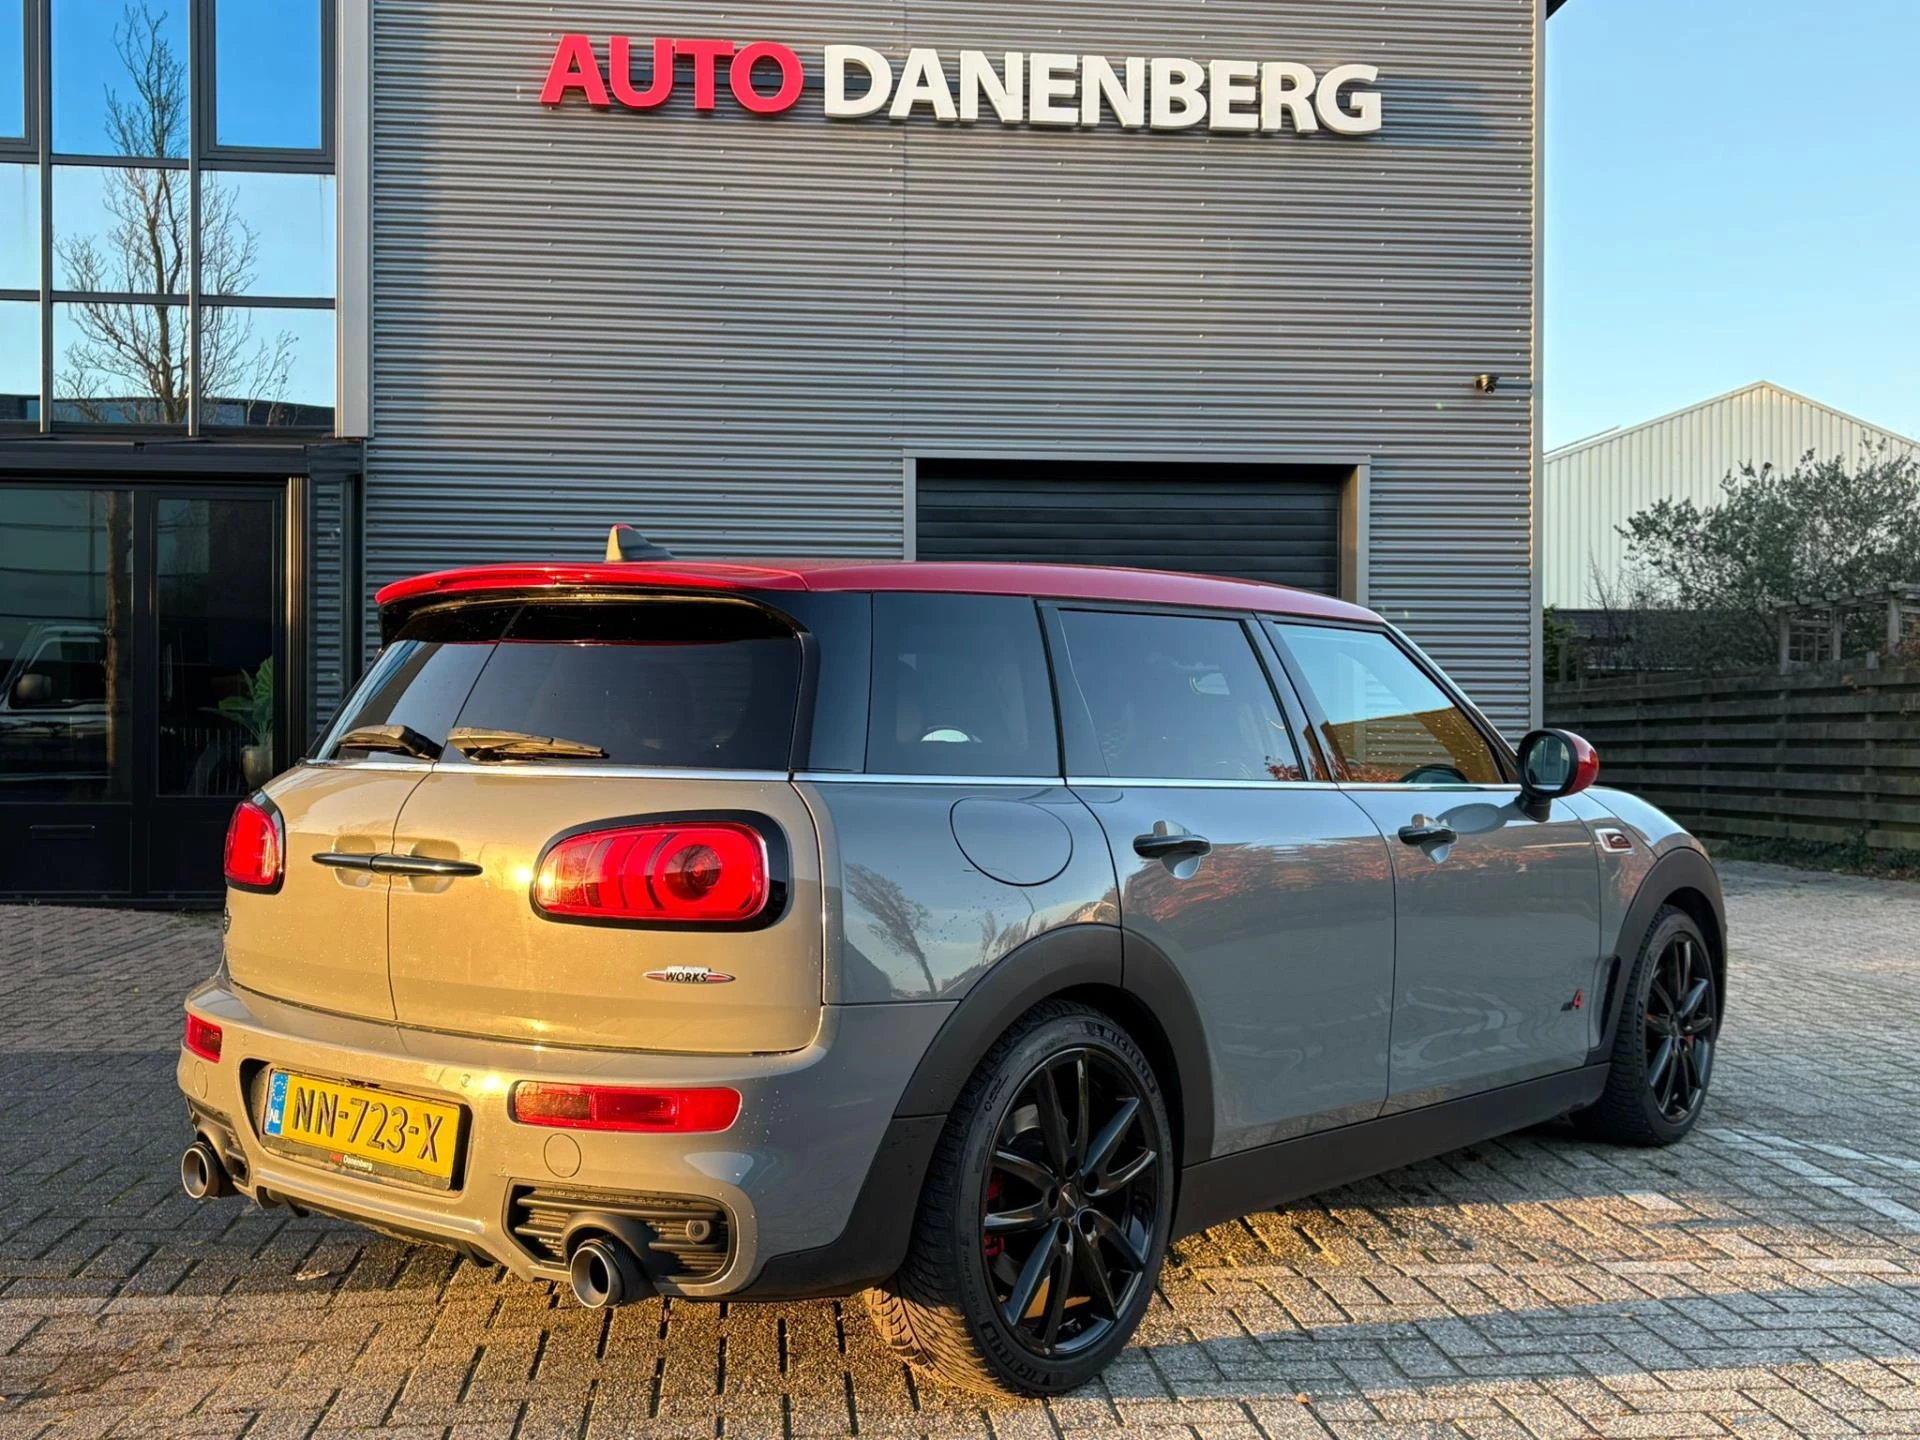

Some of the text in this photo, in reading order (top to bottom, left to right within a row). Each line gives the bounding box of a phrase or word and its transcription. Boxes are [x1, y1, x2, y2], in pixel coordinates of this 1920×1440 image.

[539, 33, 1382, 136] AUTO DANENBERG
[665, 971, 708, 983] WORKS
[268, 1109, 281, 1124] NL
[293, 1087, 443, 1162] NN-723-X
